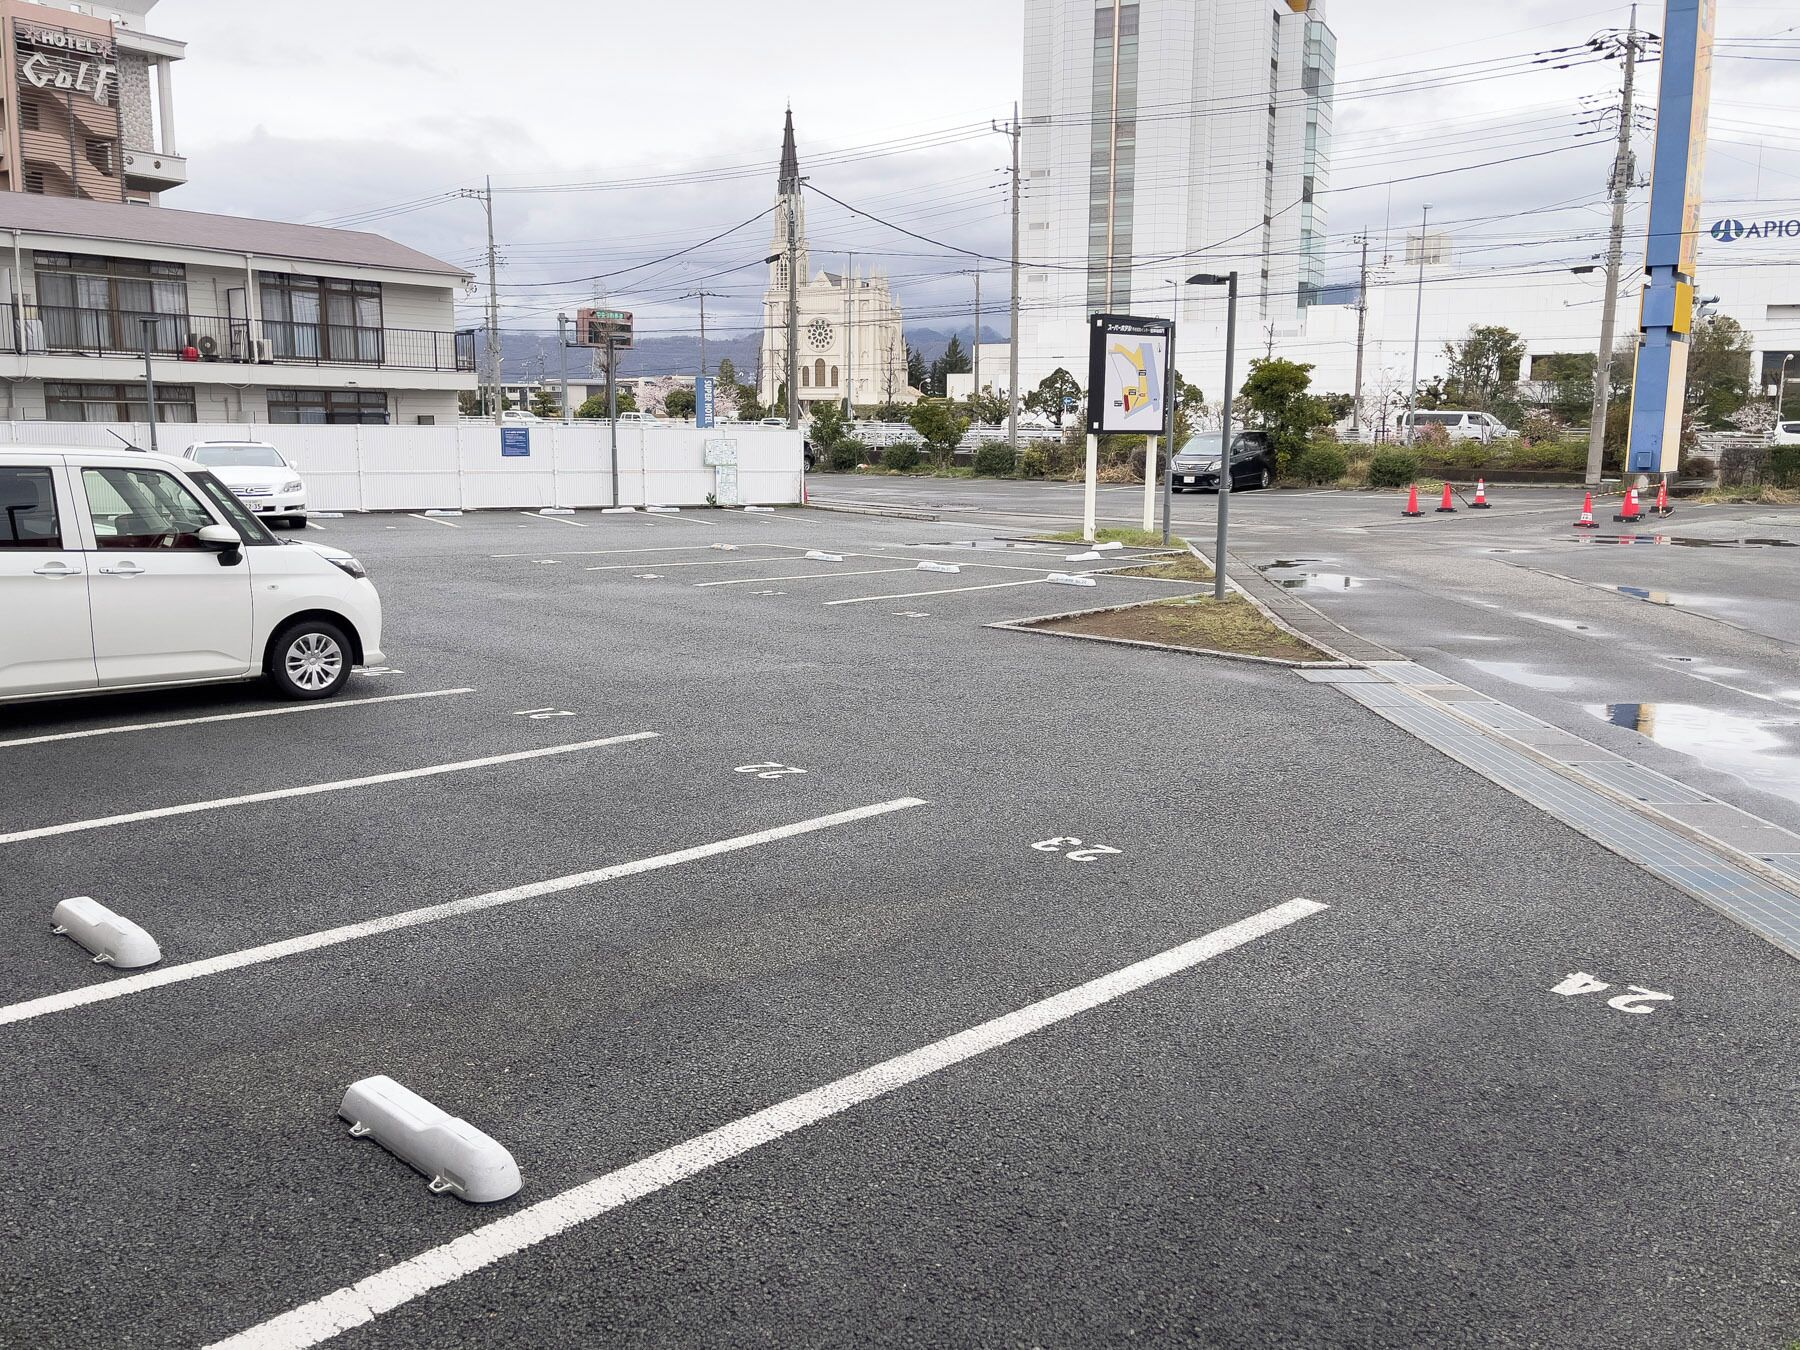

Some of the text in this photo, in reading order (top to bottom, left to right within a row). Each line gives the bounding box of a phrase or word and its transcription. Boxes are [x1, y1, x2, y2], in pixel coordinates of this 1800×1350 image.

[41, 31, 97, 53] HOTEL
[1745, 219, 1800, 238] APIO
[704, 380, 713, 401] SUPER
[704, 402, 713, 424] HOTEL
[733, 761, 808, 779] 22
[1031, 836, 1123, 862] 23
[1550, 971, 1675, 1014] 24
